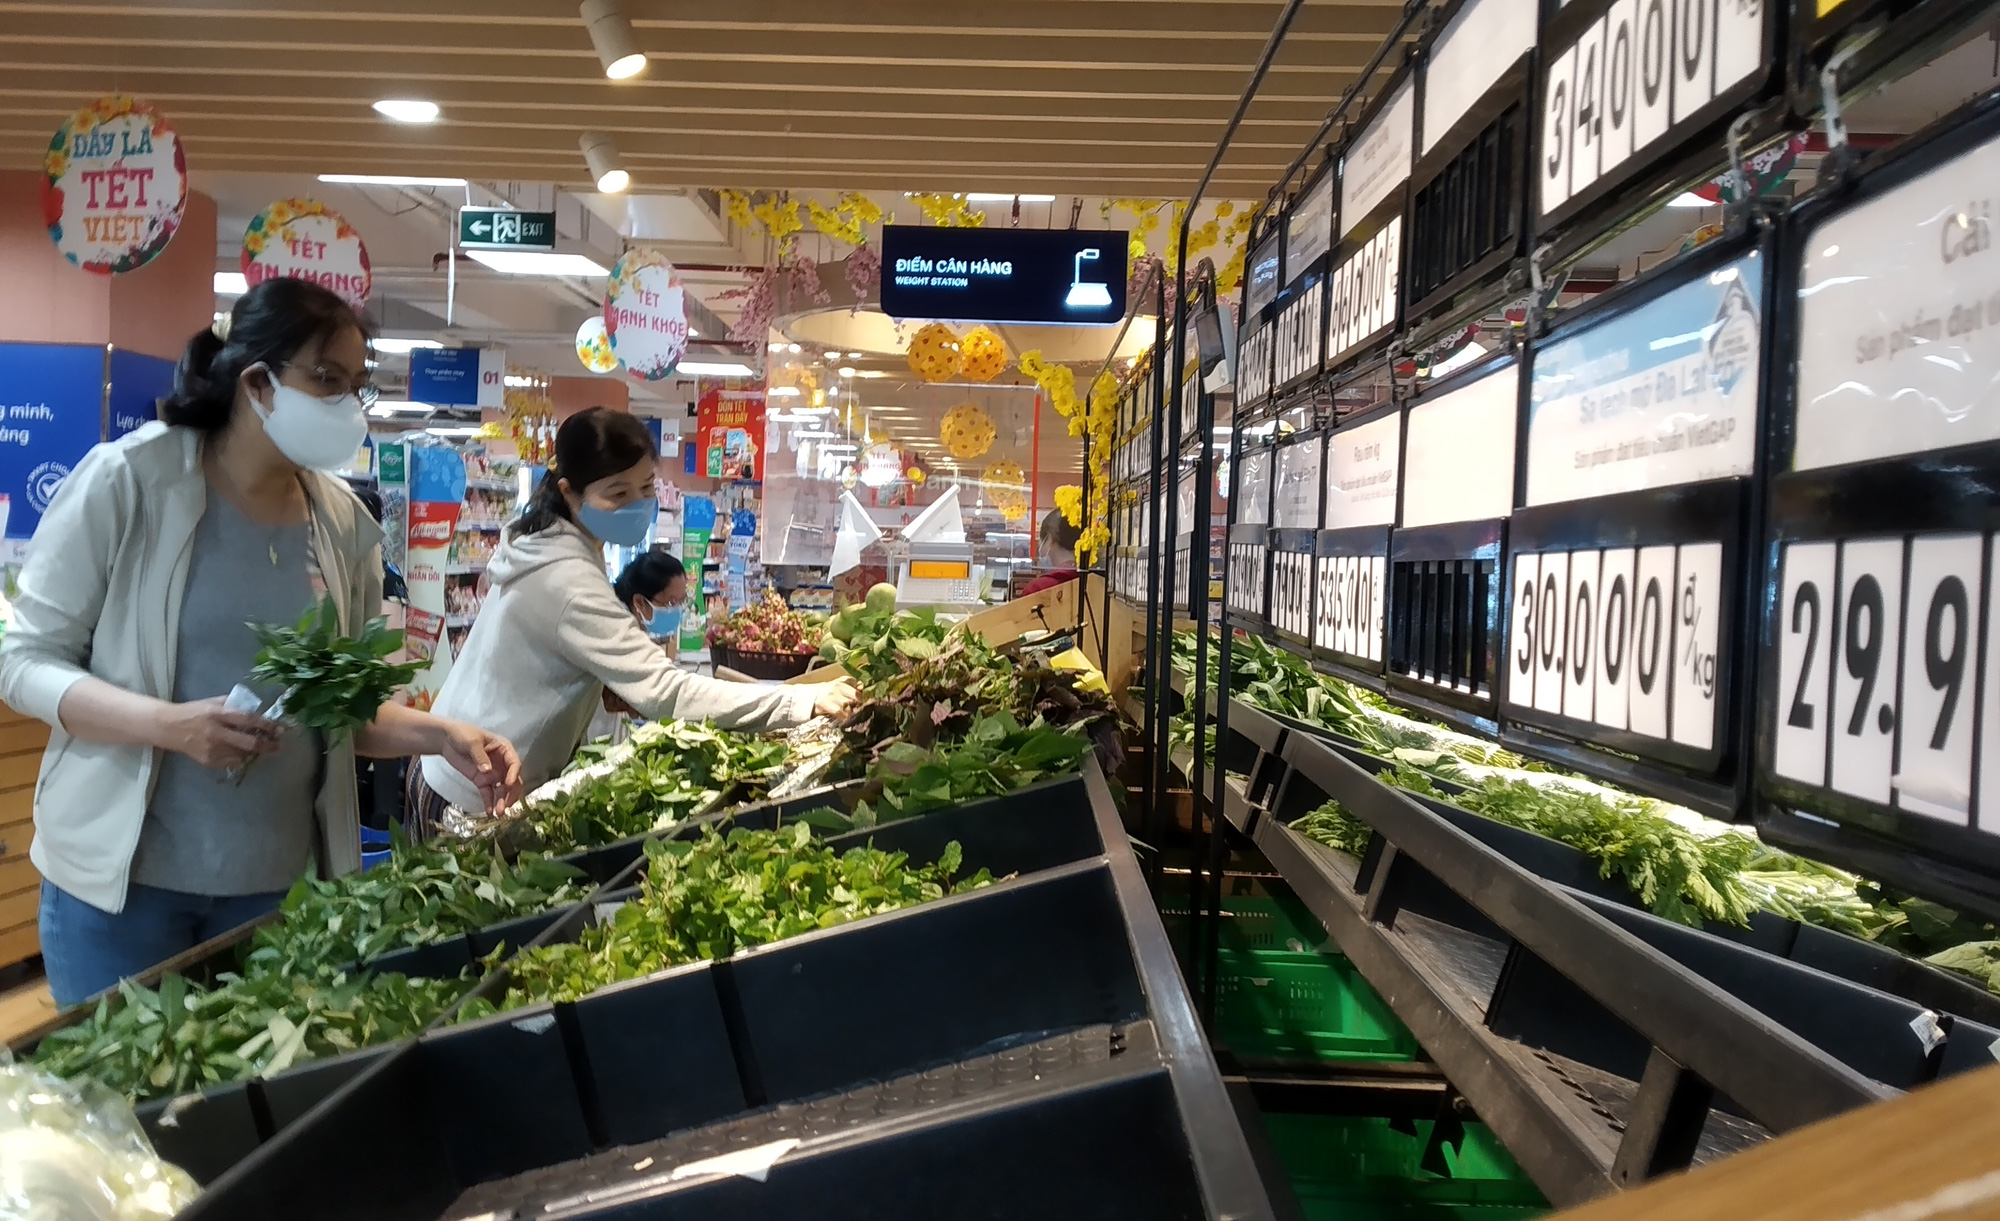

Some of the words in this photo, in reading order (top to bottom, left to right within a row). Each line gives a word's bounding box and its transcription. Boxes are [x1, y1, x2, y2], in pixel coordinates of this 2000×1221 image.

[81, 157, 154, 209] TẾT
[83, 211, 144, 245] VIỆT
[521, 223, 545, 237] EXIT
[290, 231, 327, 260] TẾT
[936, 257, 967, 274] CÂN
[970, 258, 1012, 275] HÀNG
[895, 276, 930, 286] WEIGHT
[930, 277, 968, 287] STATION
[639, 284, 660, 308] TẾT
[609, 306, 647, 329] MẠNH
[482, 370, 499, 385] 01
[663, 432, 676, 442] 03
[1517, 572, 1661, 696] 30.000
